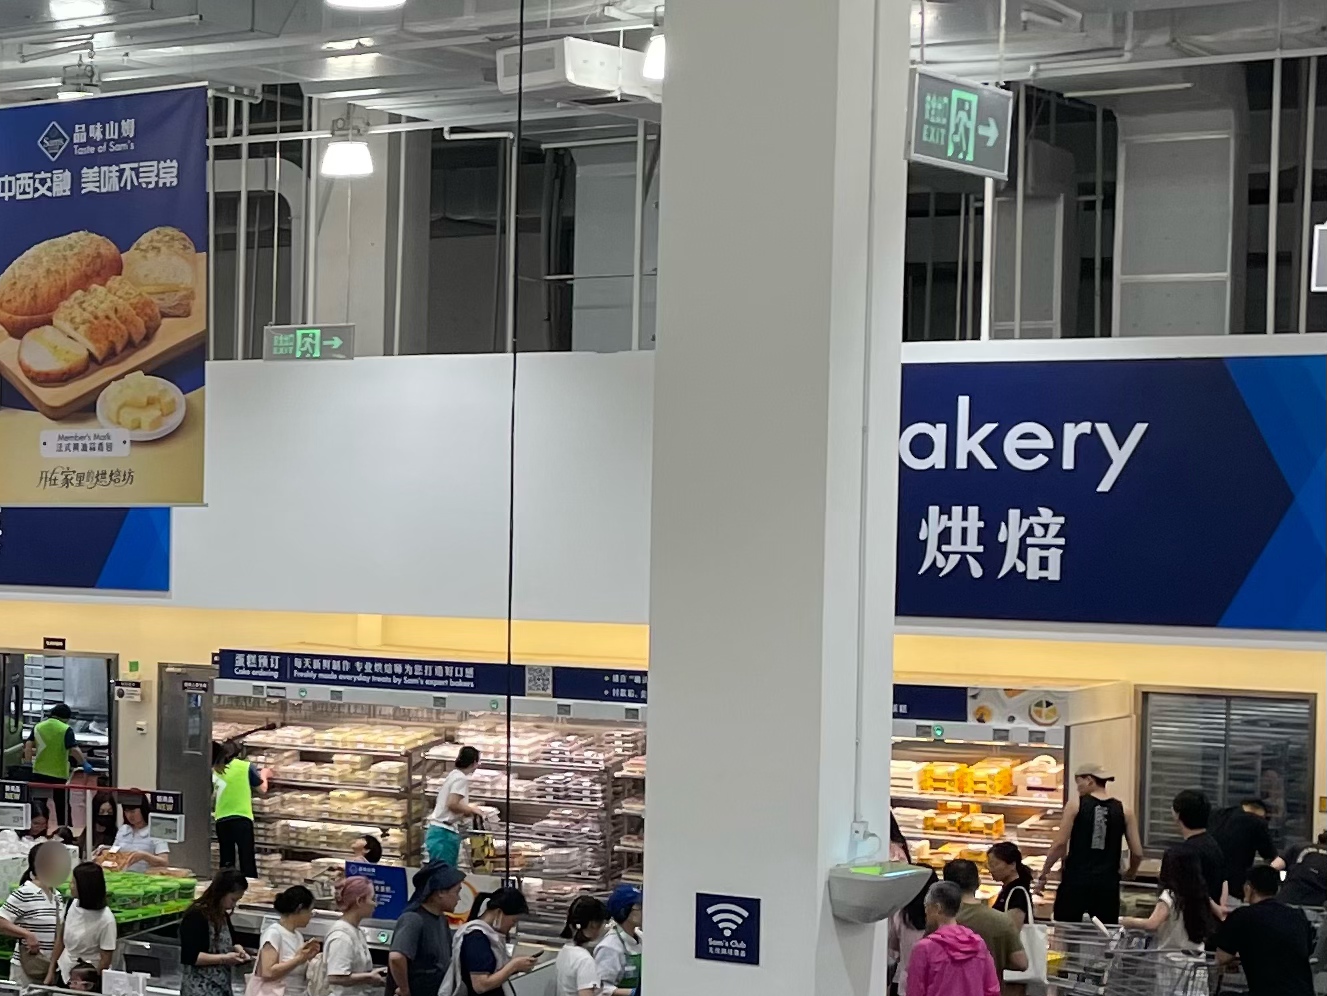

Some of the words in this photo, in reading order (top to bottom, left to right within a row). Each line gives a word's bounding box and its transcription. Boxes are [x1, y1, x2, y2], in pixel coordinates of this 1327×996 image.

[73, 118, 135, 144] 品味山姆
[922, 124, 947, 146] EXIT
[73, 144, 96, 155] Taste
[97, 143, 107, 153] of
[108, 139, 135, 152] Sam's
[80, 158, 179, 194] 美味不寻常
[273, 346, 294, 355] EXIT
[56, 433, 91, 442] Member's
[93, 433, 112, 441] Mark
[918, 505, 1066, 581] 烘焙
[234, 667, 251, 676] Cake
[251, 669, 279, 679] ordering
[293, 669, 317, 680] Freshly
[317, 672, 338, 680] made
[338, 674, 371, 683] everyday
[392, 675, 403, 685] by
[403, 676, 424, 685] Sam's
[424, 679, 449, 687] expert
[449, 678, 474, 688] bakers
[708, 937, 729, 947] Sam's
[730, 939, 747, 949] Club
